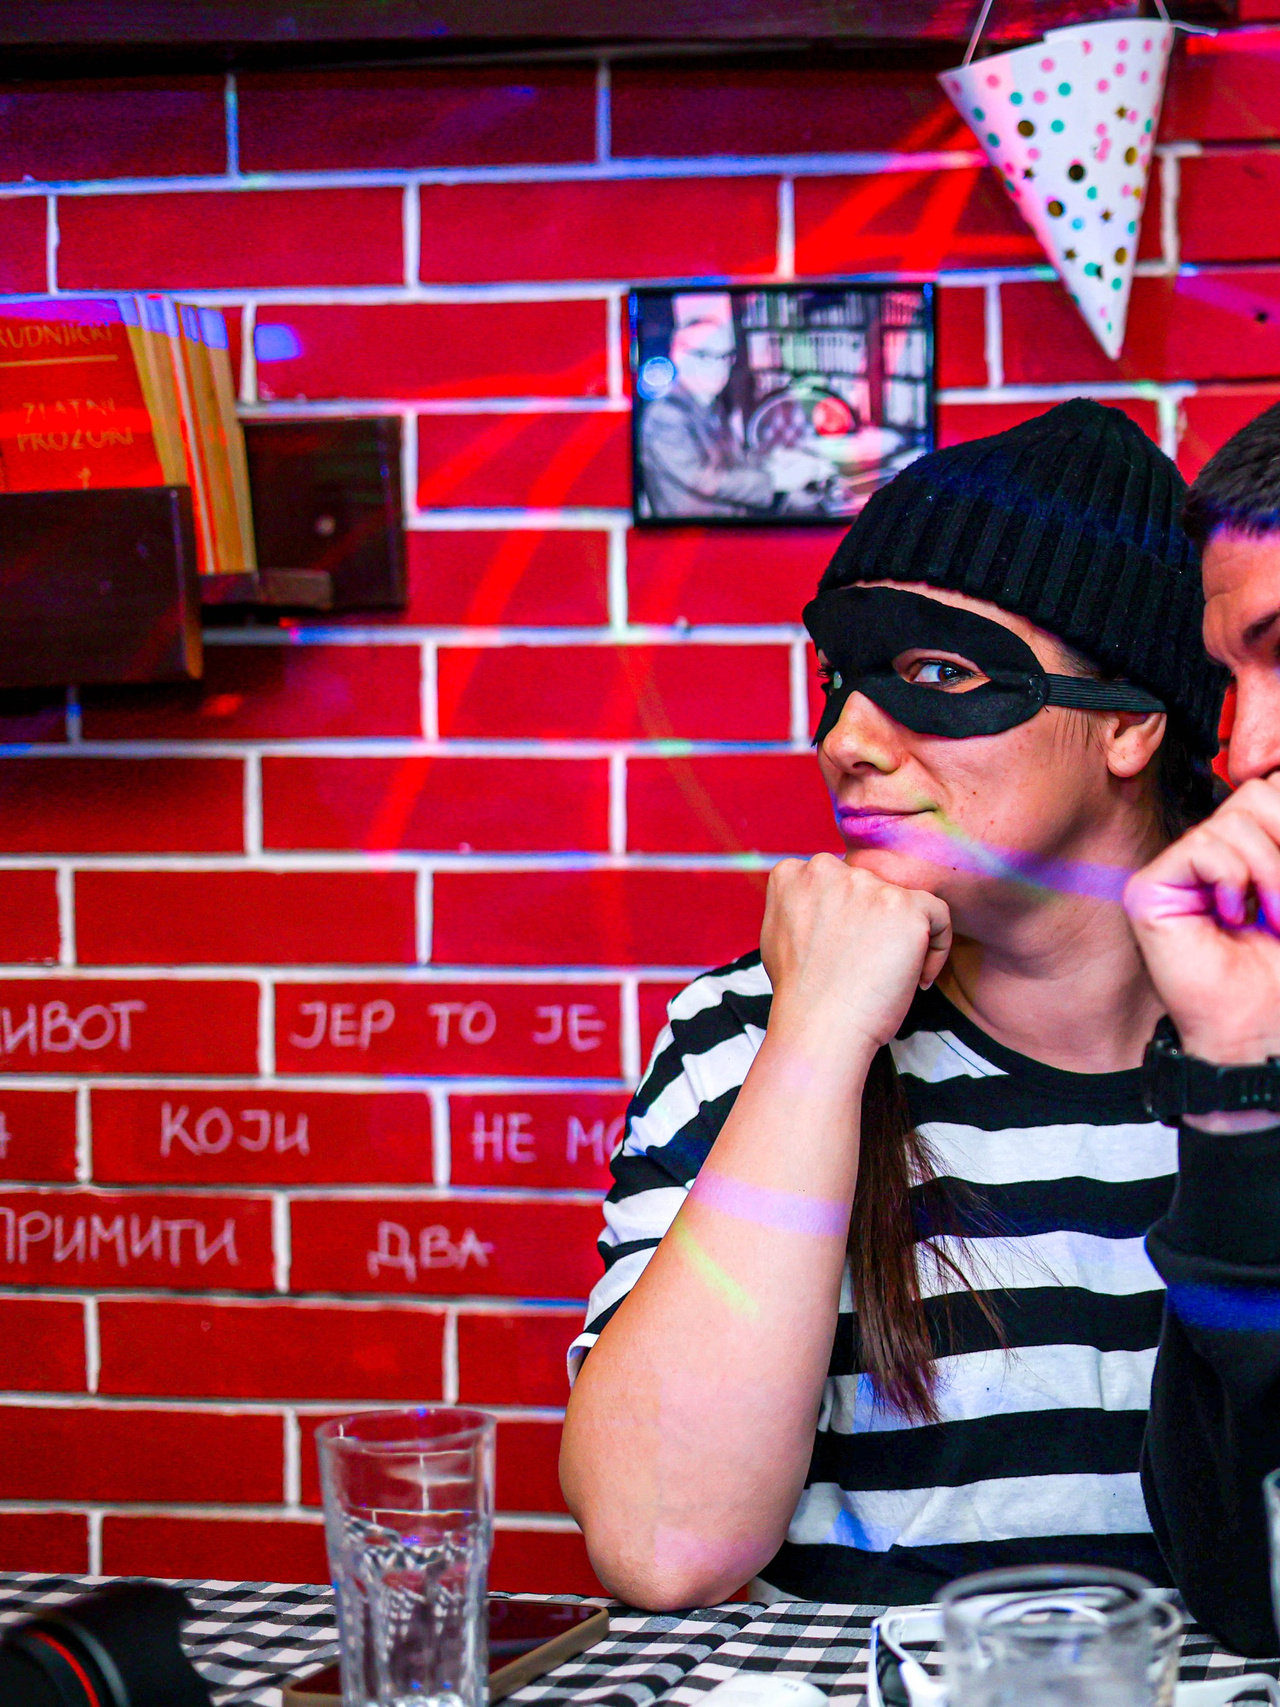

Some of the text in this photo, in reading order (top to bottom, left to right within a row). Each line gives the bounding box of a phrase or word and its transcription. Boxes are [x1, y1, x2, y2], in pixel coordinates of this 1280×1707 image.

[0, 999, 607, 1055] ИВОТ ЈЕР ТО ЈЕ
[159, 1100, 311, 1158] КОЈИ
[470, 1110, 538, 1164] НЕ
[366, 1219, 494, 1284] ДВА
